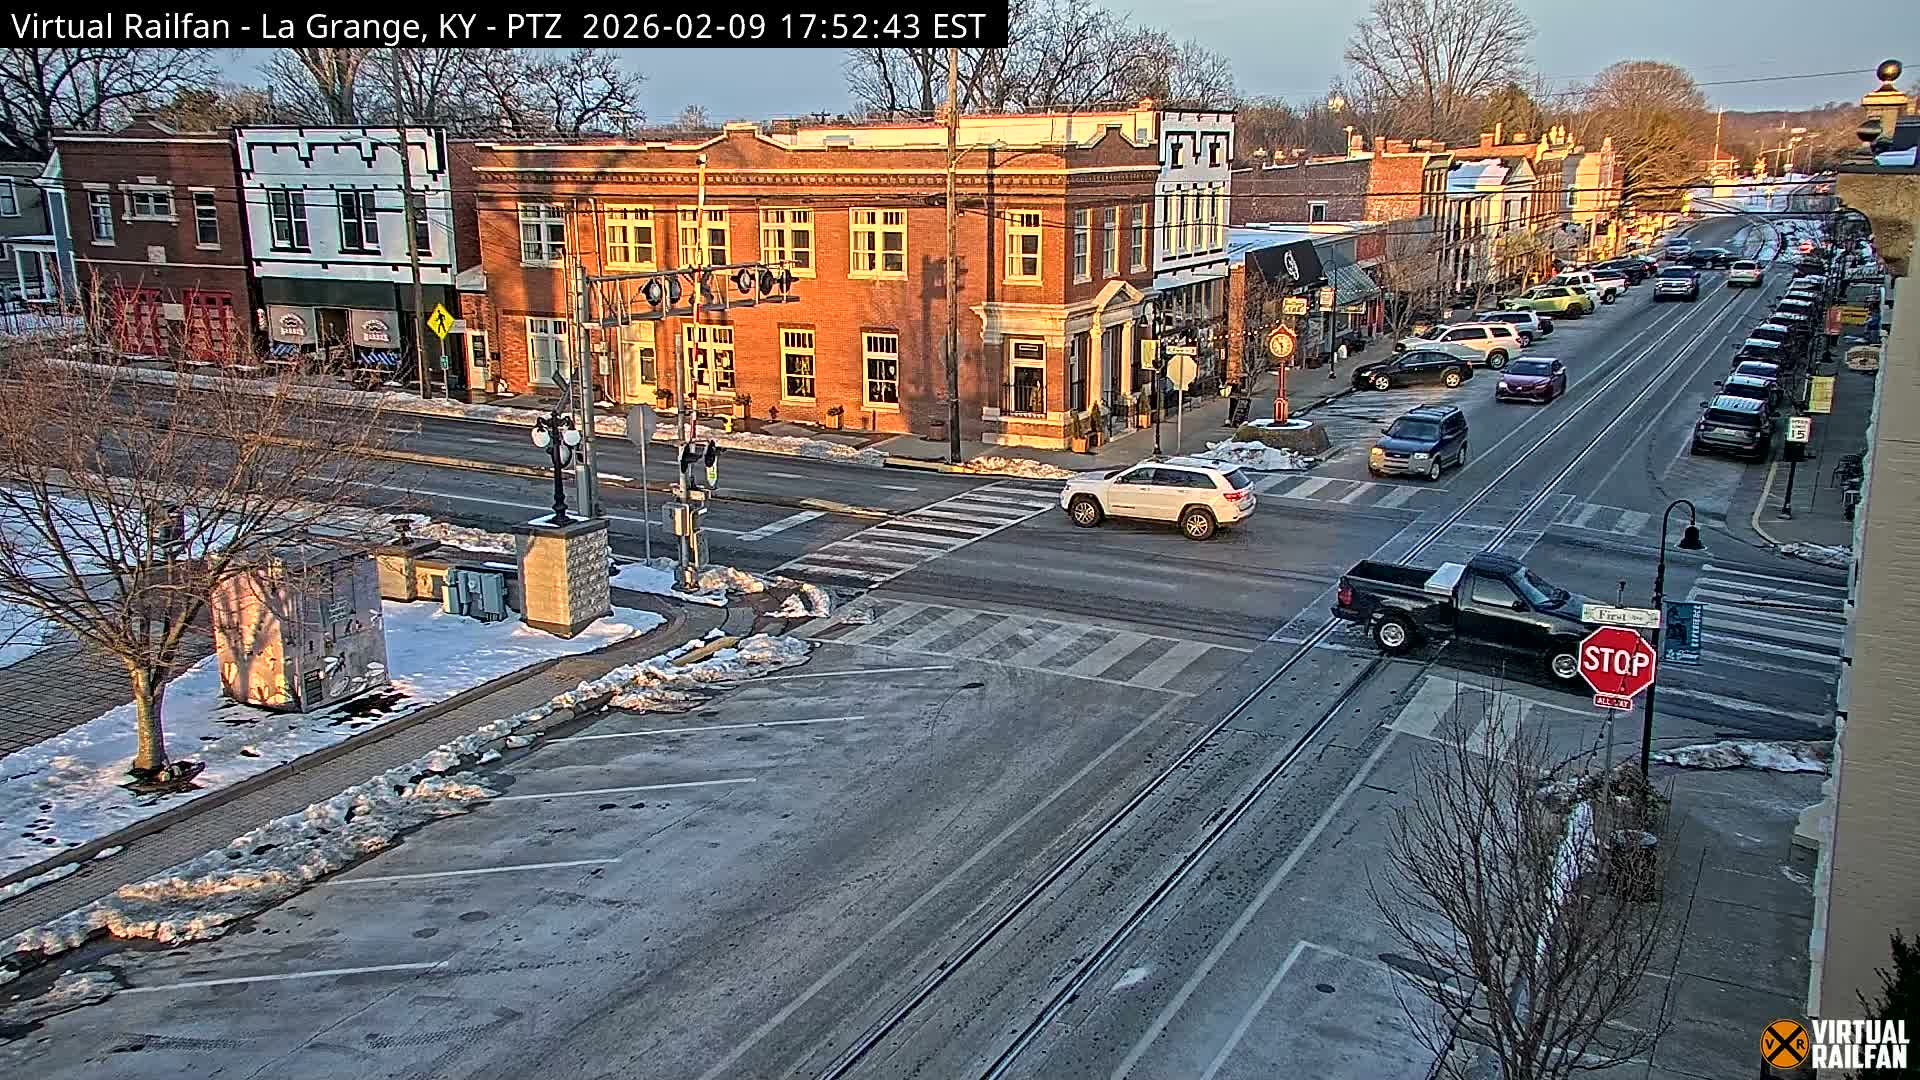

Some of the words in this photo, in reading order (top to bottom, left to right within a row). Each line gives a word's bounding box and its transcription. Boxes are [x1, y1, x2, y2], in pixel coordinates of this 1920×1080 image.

[1791, 429, 1806, 440] 15
[1599, 609, 1627, 622] First
[1583, 645, 1650, 677] STOP
[1597, 696, 1609, 706] ALL
